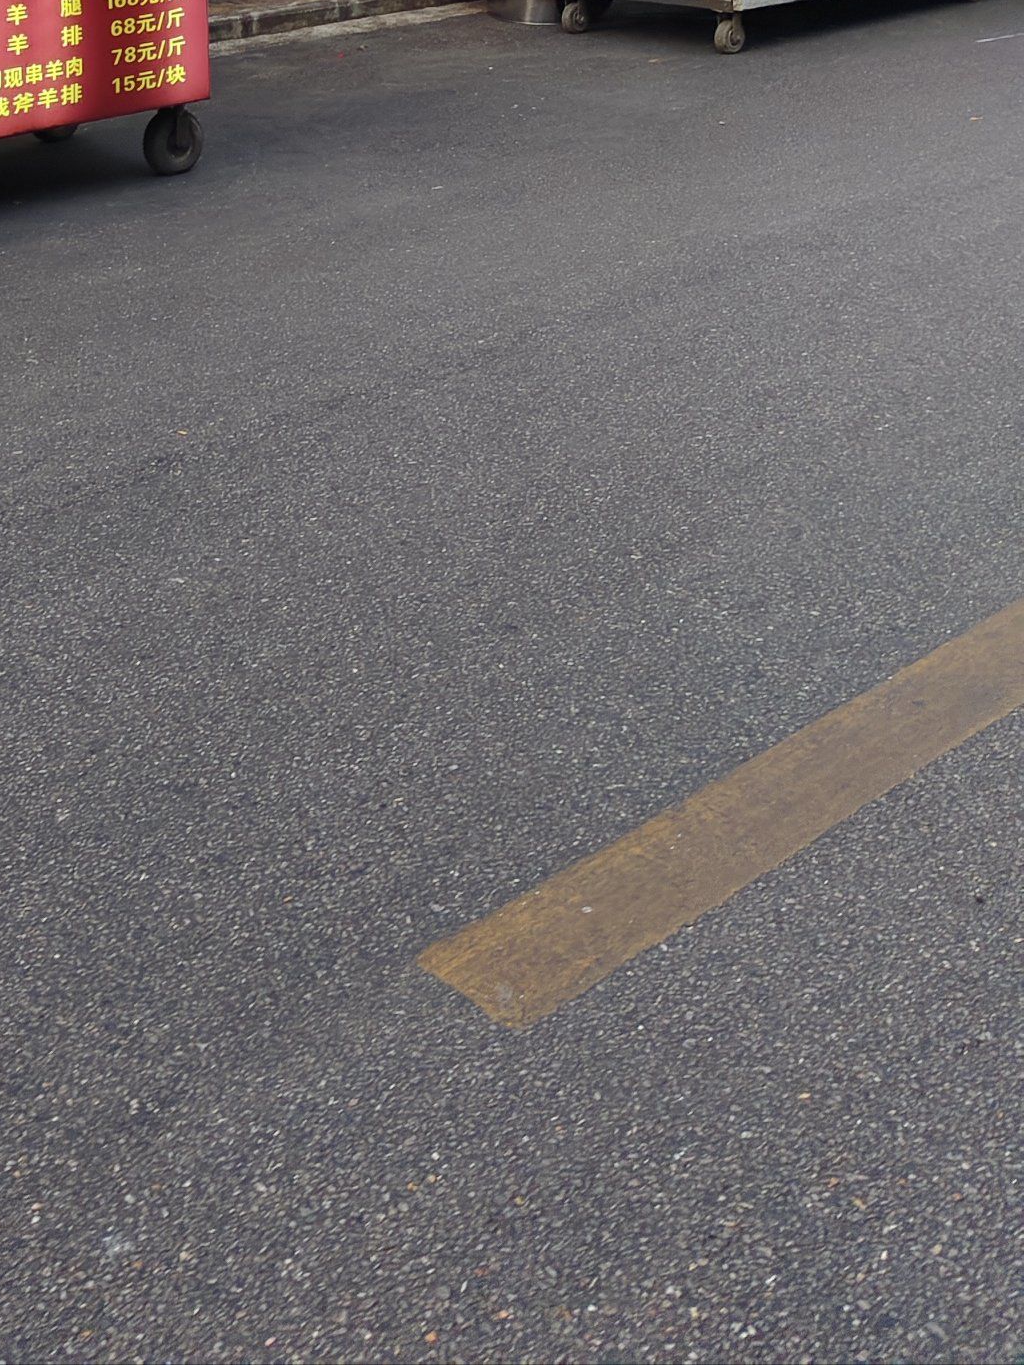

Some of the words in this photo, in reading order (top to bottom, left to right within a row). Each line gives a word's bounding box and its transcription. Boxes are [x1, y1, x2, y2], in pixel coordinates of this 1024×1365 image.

[110, 8, 185, 37] 68元/斤
[111, 36, 185, 65] 78元/斤
[112, 65, 186, 94] 15元/块
